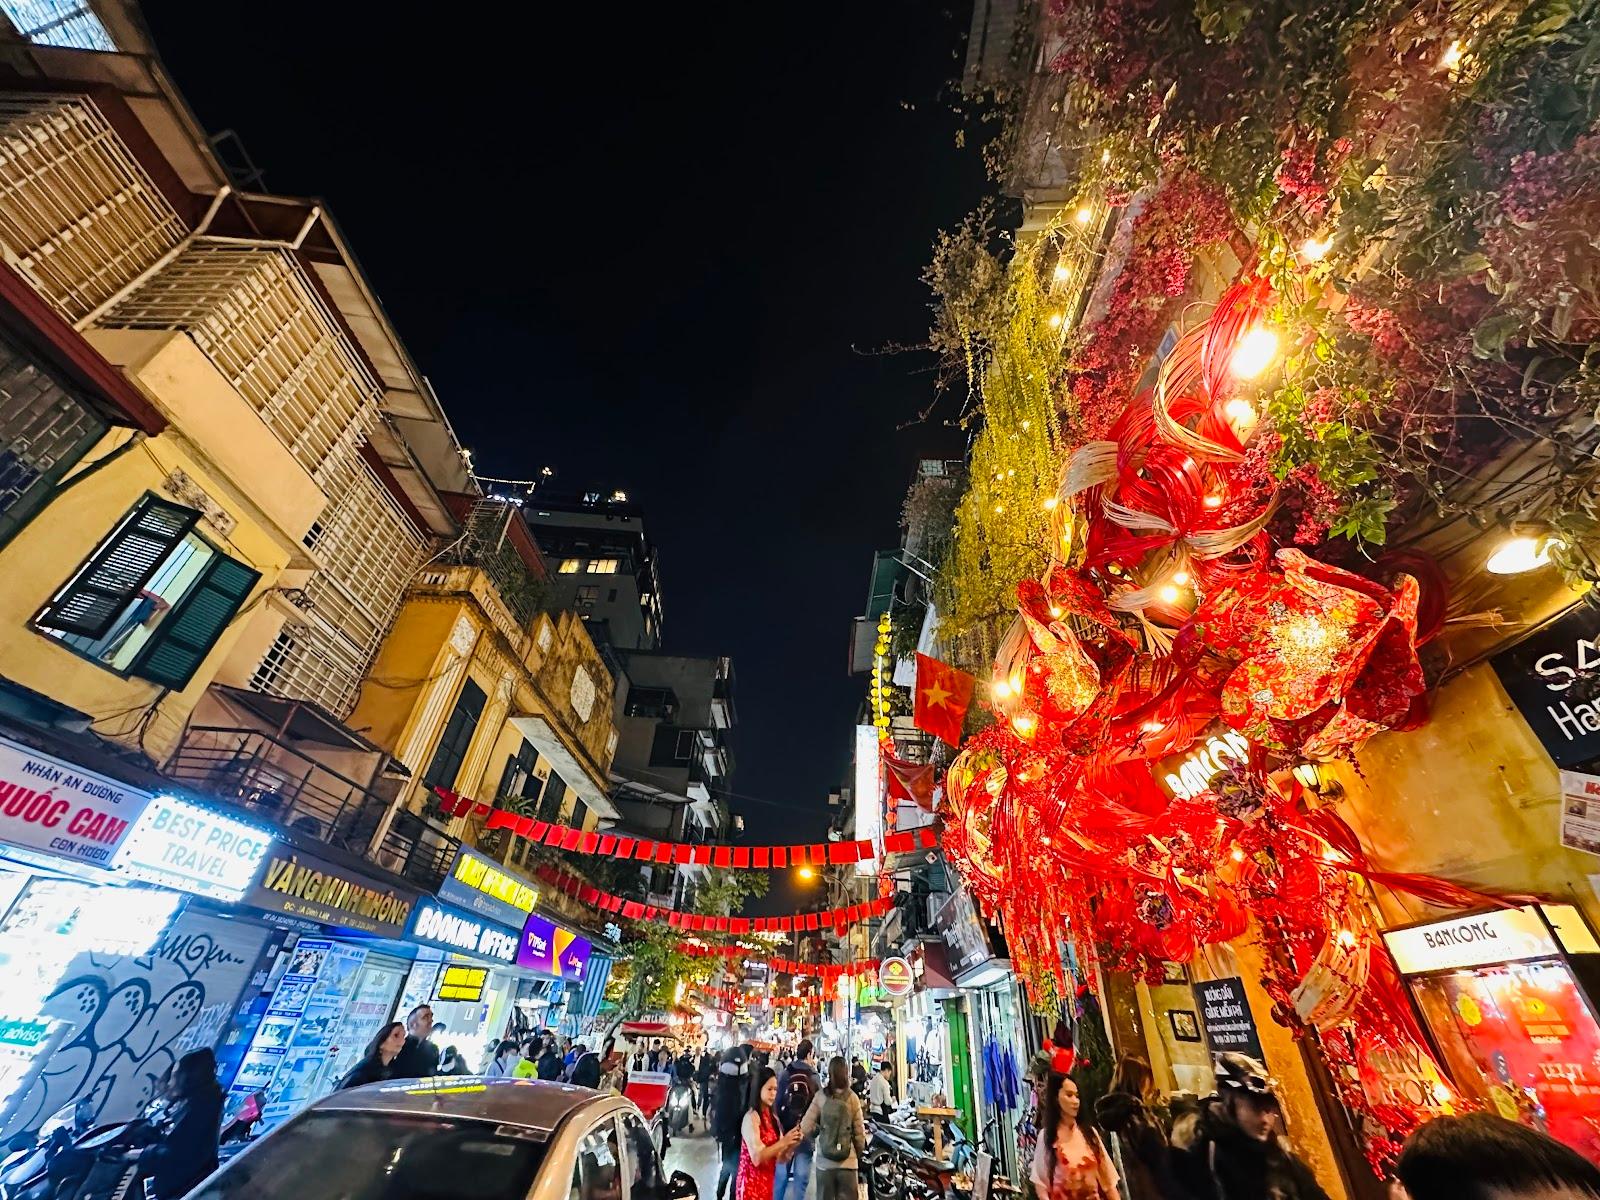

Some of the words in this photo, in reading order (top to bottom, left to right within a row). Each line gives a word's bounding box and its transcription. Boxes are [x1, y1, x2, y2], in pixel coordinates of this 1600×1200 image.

[1547, 697, 1600, 741] Ha
[62, 775, 83, 790] AN
[50, 837, 78, 852] CON
[67, 807, 129, 846] CAM
[152, 807, 205, 842] BEST
[205, 826, 263, 862] PRICE
[161, 842, 228, 878] TRAVEL
[264, 855, 323, 900] VÀNG
[318, 874, 364, 913] MINH
[360, 889, 410, 927] THÔNG
[414, 907, 481, 951] BOOKING
[479, 928, 518, 961] OFFICE
[1424, 921, 1497, 949] BANCONG
